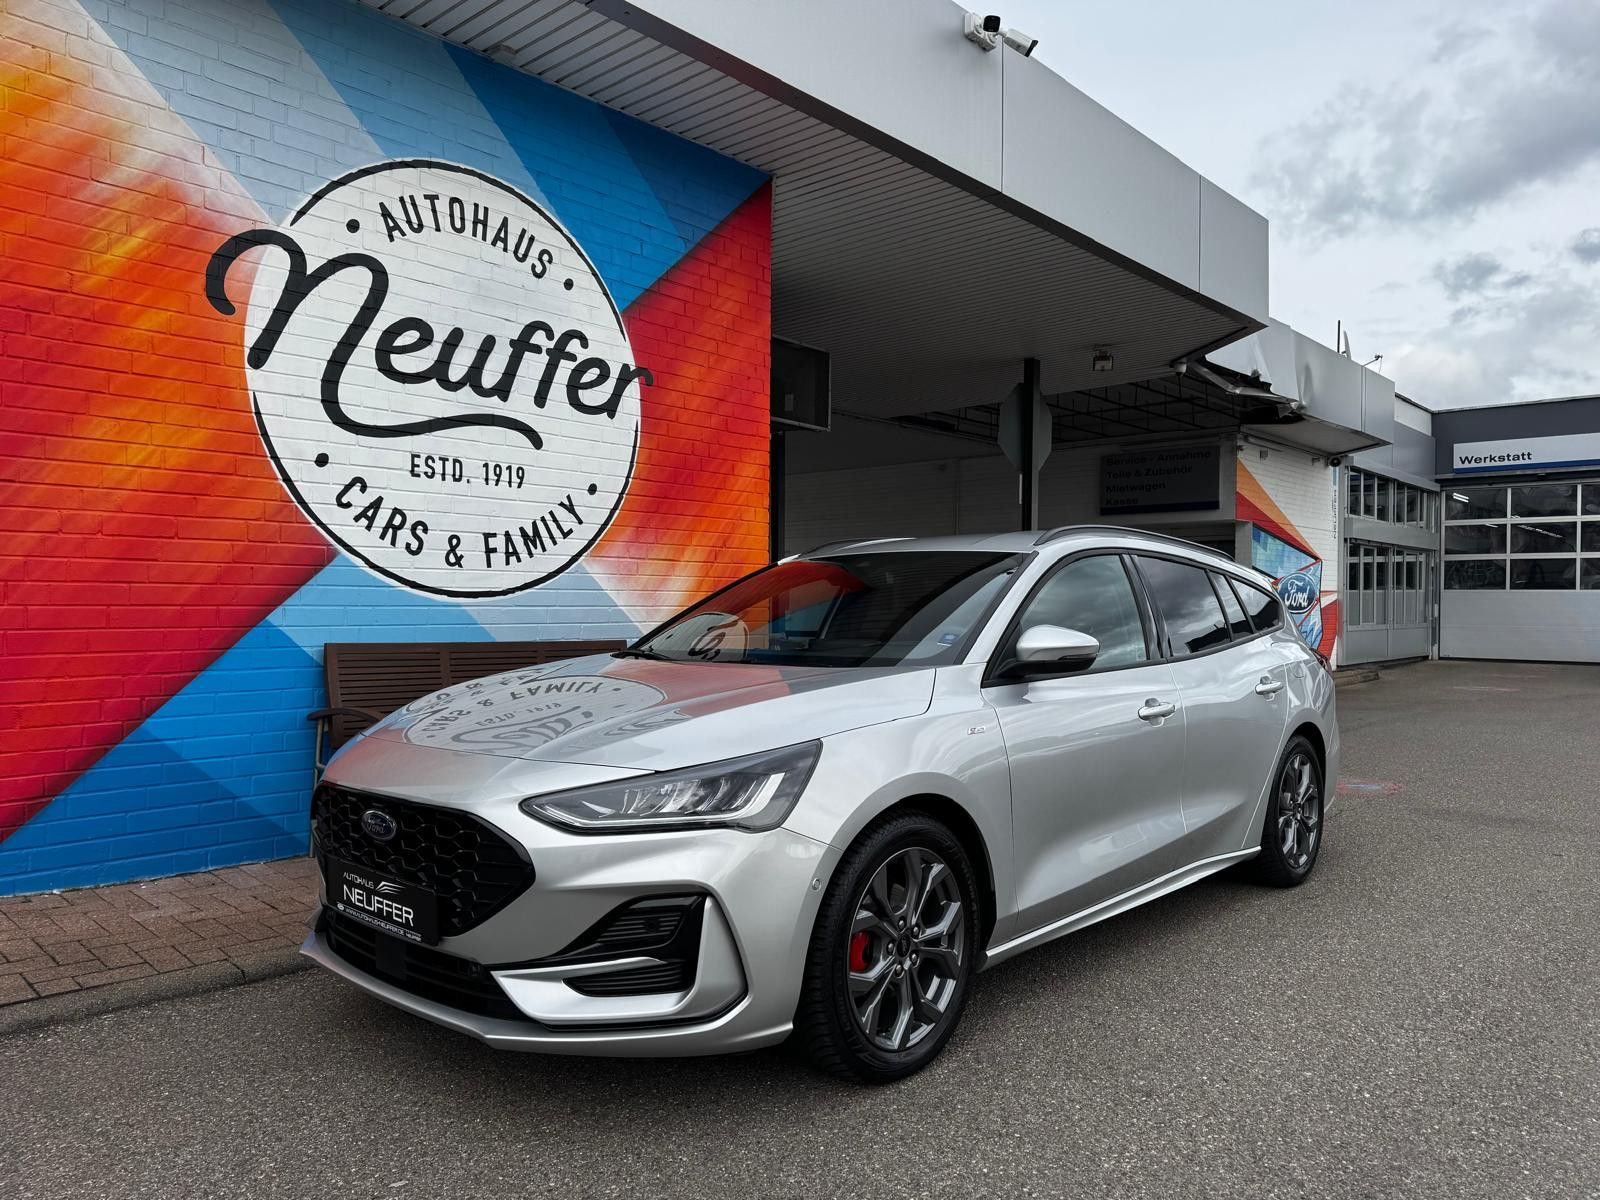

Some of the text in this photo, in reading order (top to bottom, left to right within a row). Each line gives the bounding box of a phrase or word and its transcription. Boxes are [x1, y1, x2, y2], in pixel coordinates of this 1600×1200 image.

[379, 194, 554, 280] AUTOHAUS
[205, 228, 654, 451] Neuffer
[410, 454, 526, 489] ESTD. 1919
[1459, 451, 1533, 465] Werkstatt
[335, 476, 585, 569] CARS & FAMILY
[1284, 579, 1310, 607] Ford
[343, 871, 375, 890] AUTOHAUS
[343, 884, 414, 927] NEUFFER
